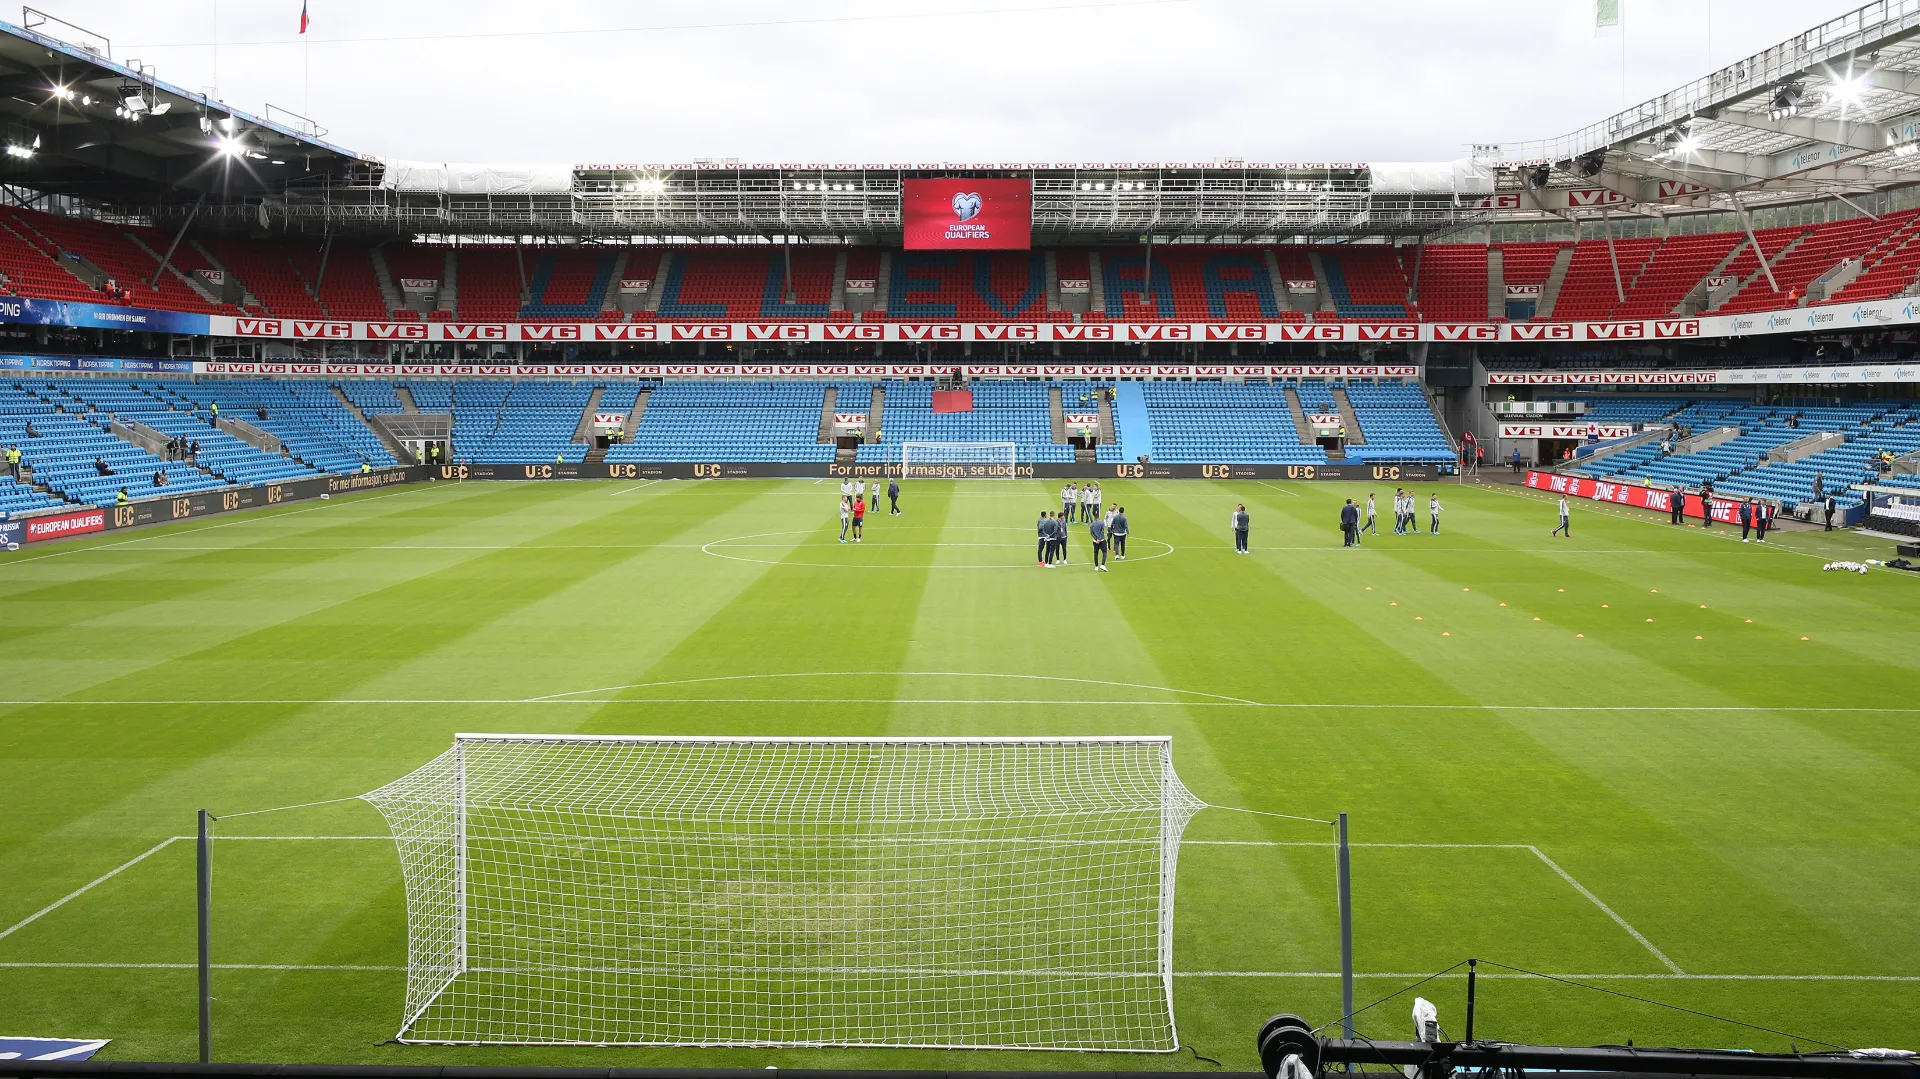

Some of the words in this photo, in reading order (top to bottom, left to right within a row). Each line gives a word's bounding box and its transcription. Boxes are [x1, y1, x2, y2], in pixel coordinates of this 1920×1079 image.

[238, 320, 280, 335] VG
[296, 322, 350, 338] VG
[369, 324, 427, 338] VG
[444, 325, 504, 339] VG
[522, 325, 582, 339] VG
[596, 325, 656, 339] VG
[674, 325, 734, 339] VG
[748, 325, 808, 339] VG
[826, 325, 886, 339] VG
[900, 325, 960, 339] VG
[976, 325, 1036, 339] VG
[1054, 325, 1114, 339] VG
[1130, 325, 1190, 339] VG
[1206, 325, 1266, 339] VG
[1282, 325, 1342, 339] VG
[1360, 325, 1420, 339] VG
[1436, 325, 1496, 339] VG
[1513, 326, 1570, 339] VG
[1589, 324, 1642, 338] VG
[1656, 321, 1698, 337] VG
[1491, 375, 1524, 383] VG
[1530, 375, 1562, 383] VG
[1568, 375, 1600, 383] VG
[1606, 374, 1634, 382] VG
[1640, 374, 1666, 382] VG
[1698, 374, 1716, 382] VG
[1506, 427, 1541, 436] VG
[1554, 428, 1587, 436] VG
[1600, 428, 1628, 437] VG
[442, 466, 468, 478] UBC
[526, 466, 552, 478] UBC
[610, 464, 636, 477] UBC
[695, 464, 720, 477] UBC
[829, 464, 852, 475] For
[855, 466, 881, 475] mer
[970, 466, 985, 475] se
[1117, 465, 1144, 478] UBC
[1203, 465, 1229, 478] UBC
[1288, 466, 1314, 478] UBC
[1373, 467, 1399, 480] UBC
[329, 479, 339, 491] For
[340, 479, 350, 490] mer
[383, 473, 389, 483] se
[1550, 476, 1567, 492] TINE
[224, 492, 238, 510] UBC
[268, 486, 281, 503] UBC
[1645, 491, 1669, 509] TINE
[173, 498, 189, 518] UBC
[1710, 500, 1733, 520] INE
[115, 506, 134, 526] UBC
[37, 522, 69, 534] EUROPEAN
[71, 515, 103, 528] QUALIFIERS
